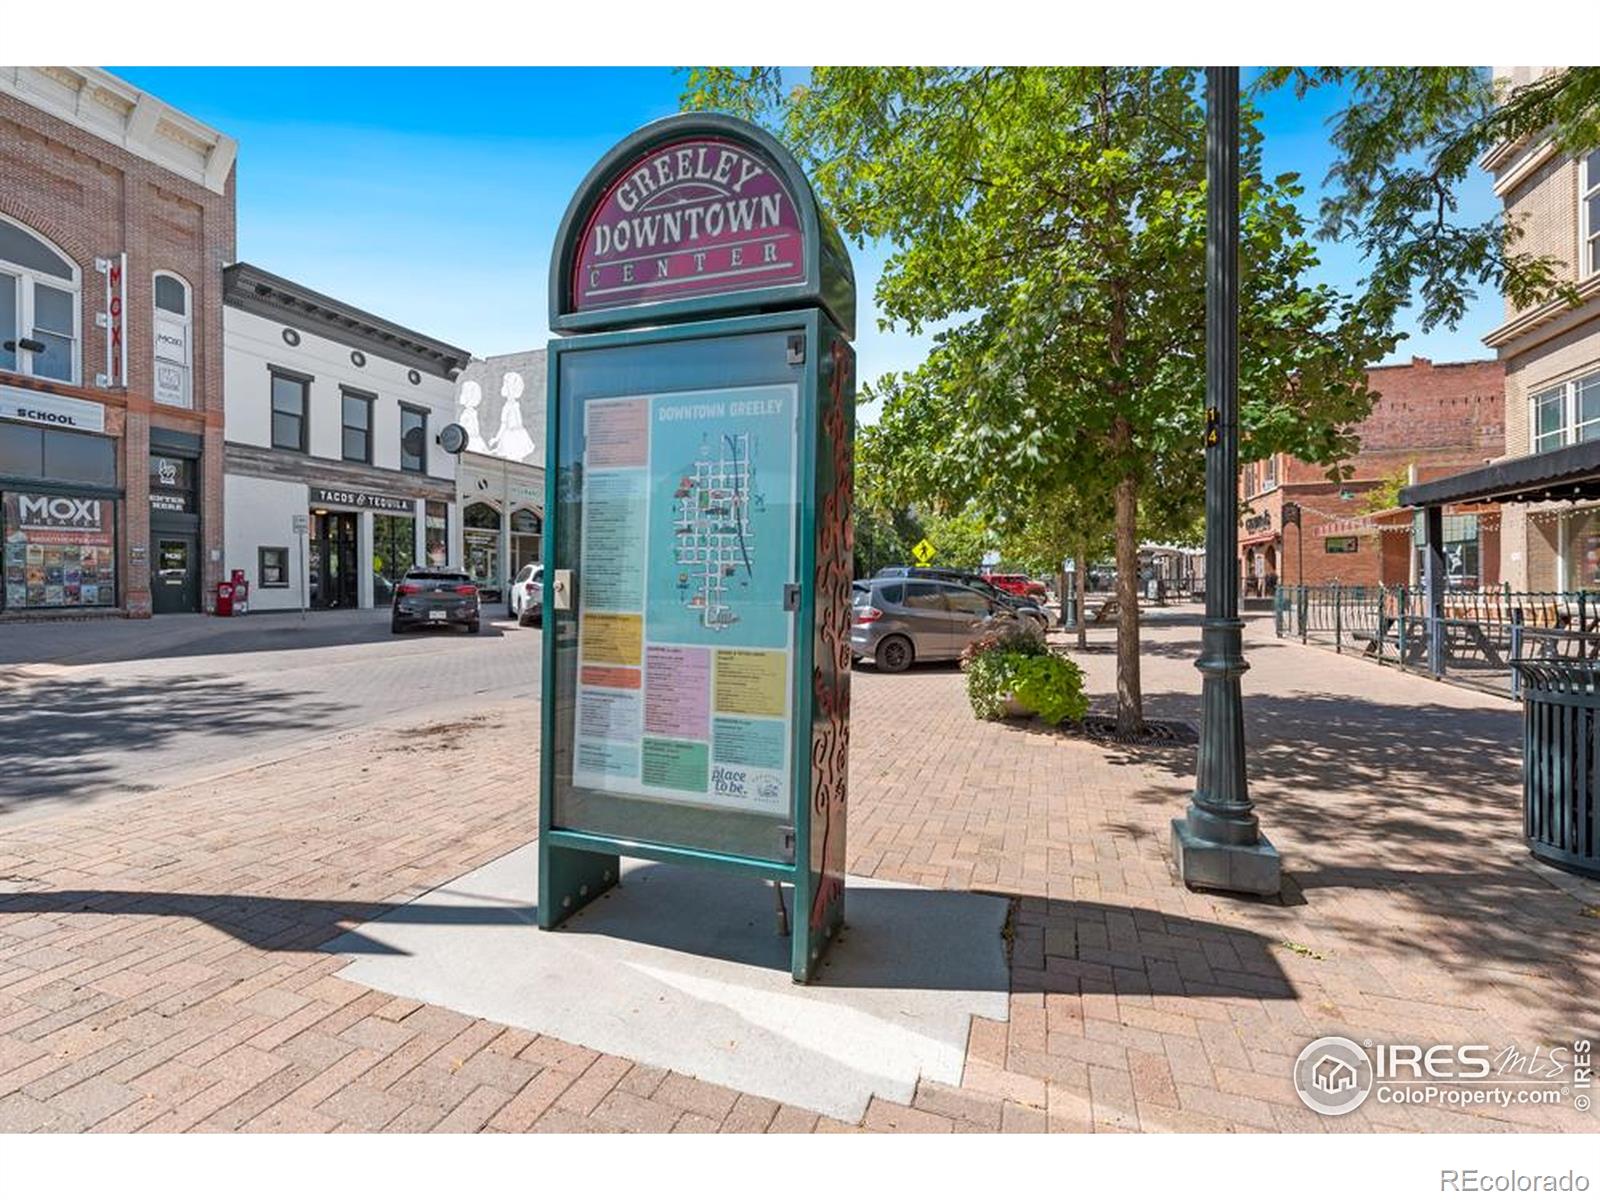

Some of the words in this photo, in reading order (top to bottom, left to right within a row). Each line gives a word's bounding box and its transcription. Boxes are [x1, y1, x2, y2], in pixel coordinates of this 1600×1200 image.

[616, 147, 763, 213] GREELEY
[594, 193, 782, 256] DOWNTOWN
[589, 243, 777, 288] CENTER
[110, 265, 122, 377] MOXI
[17, 408, 77, 426] SCHOOL
[659, 404, 725, 421] DOWNTOWN
[730, 399, 783, 416] GREELEY
[19, 495, 100, 521] MOXI
[320, 490, 354, 504] TACOS
[368, 496, 407, 510] TEQUILA
[711, 767, 746, 782] place
[715, 779, 728, 792] to
